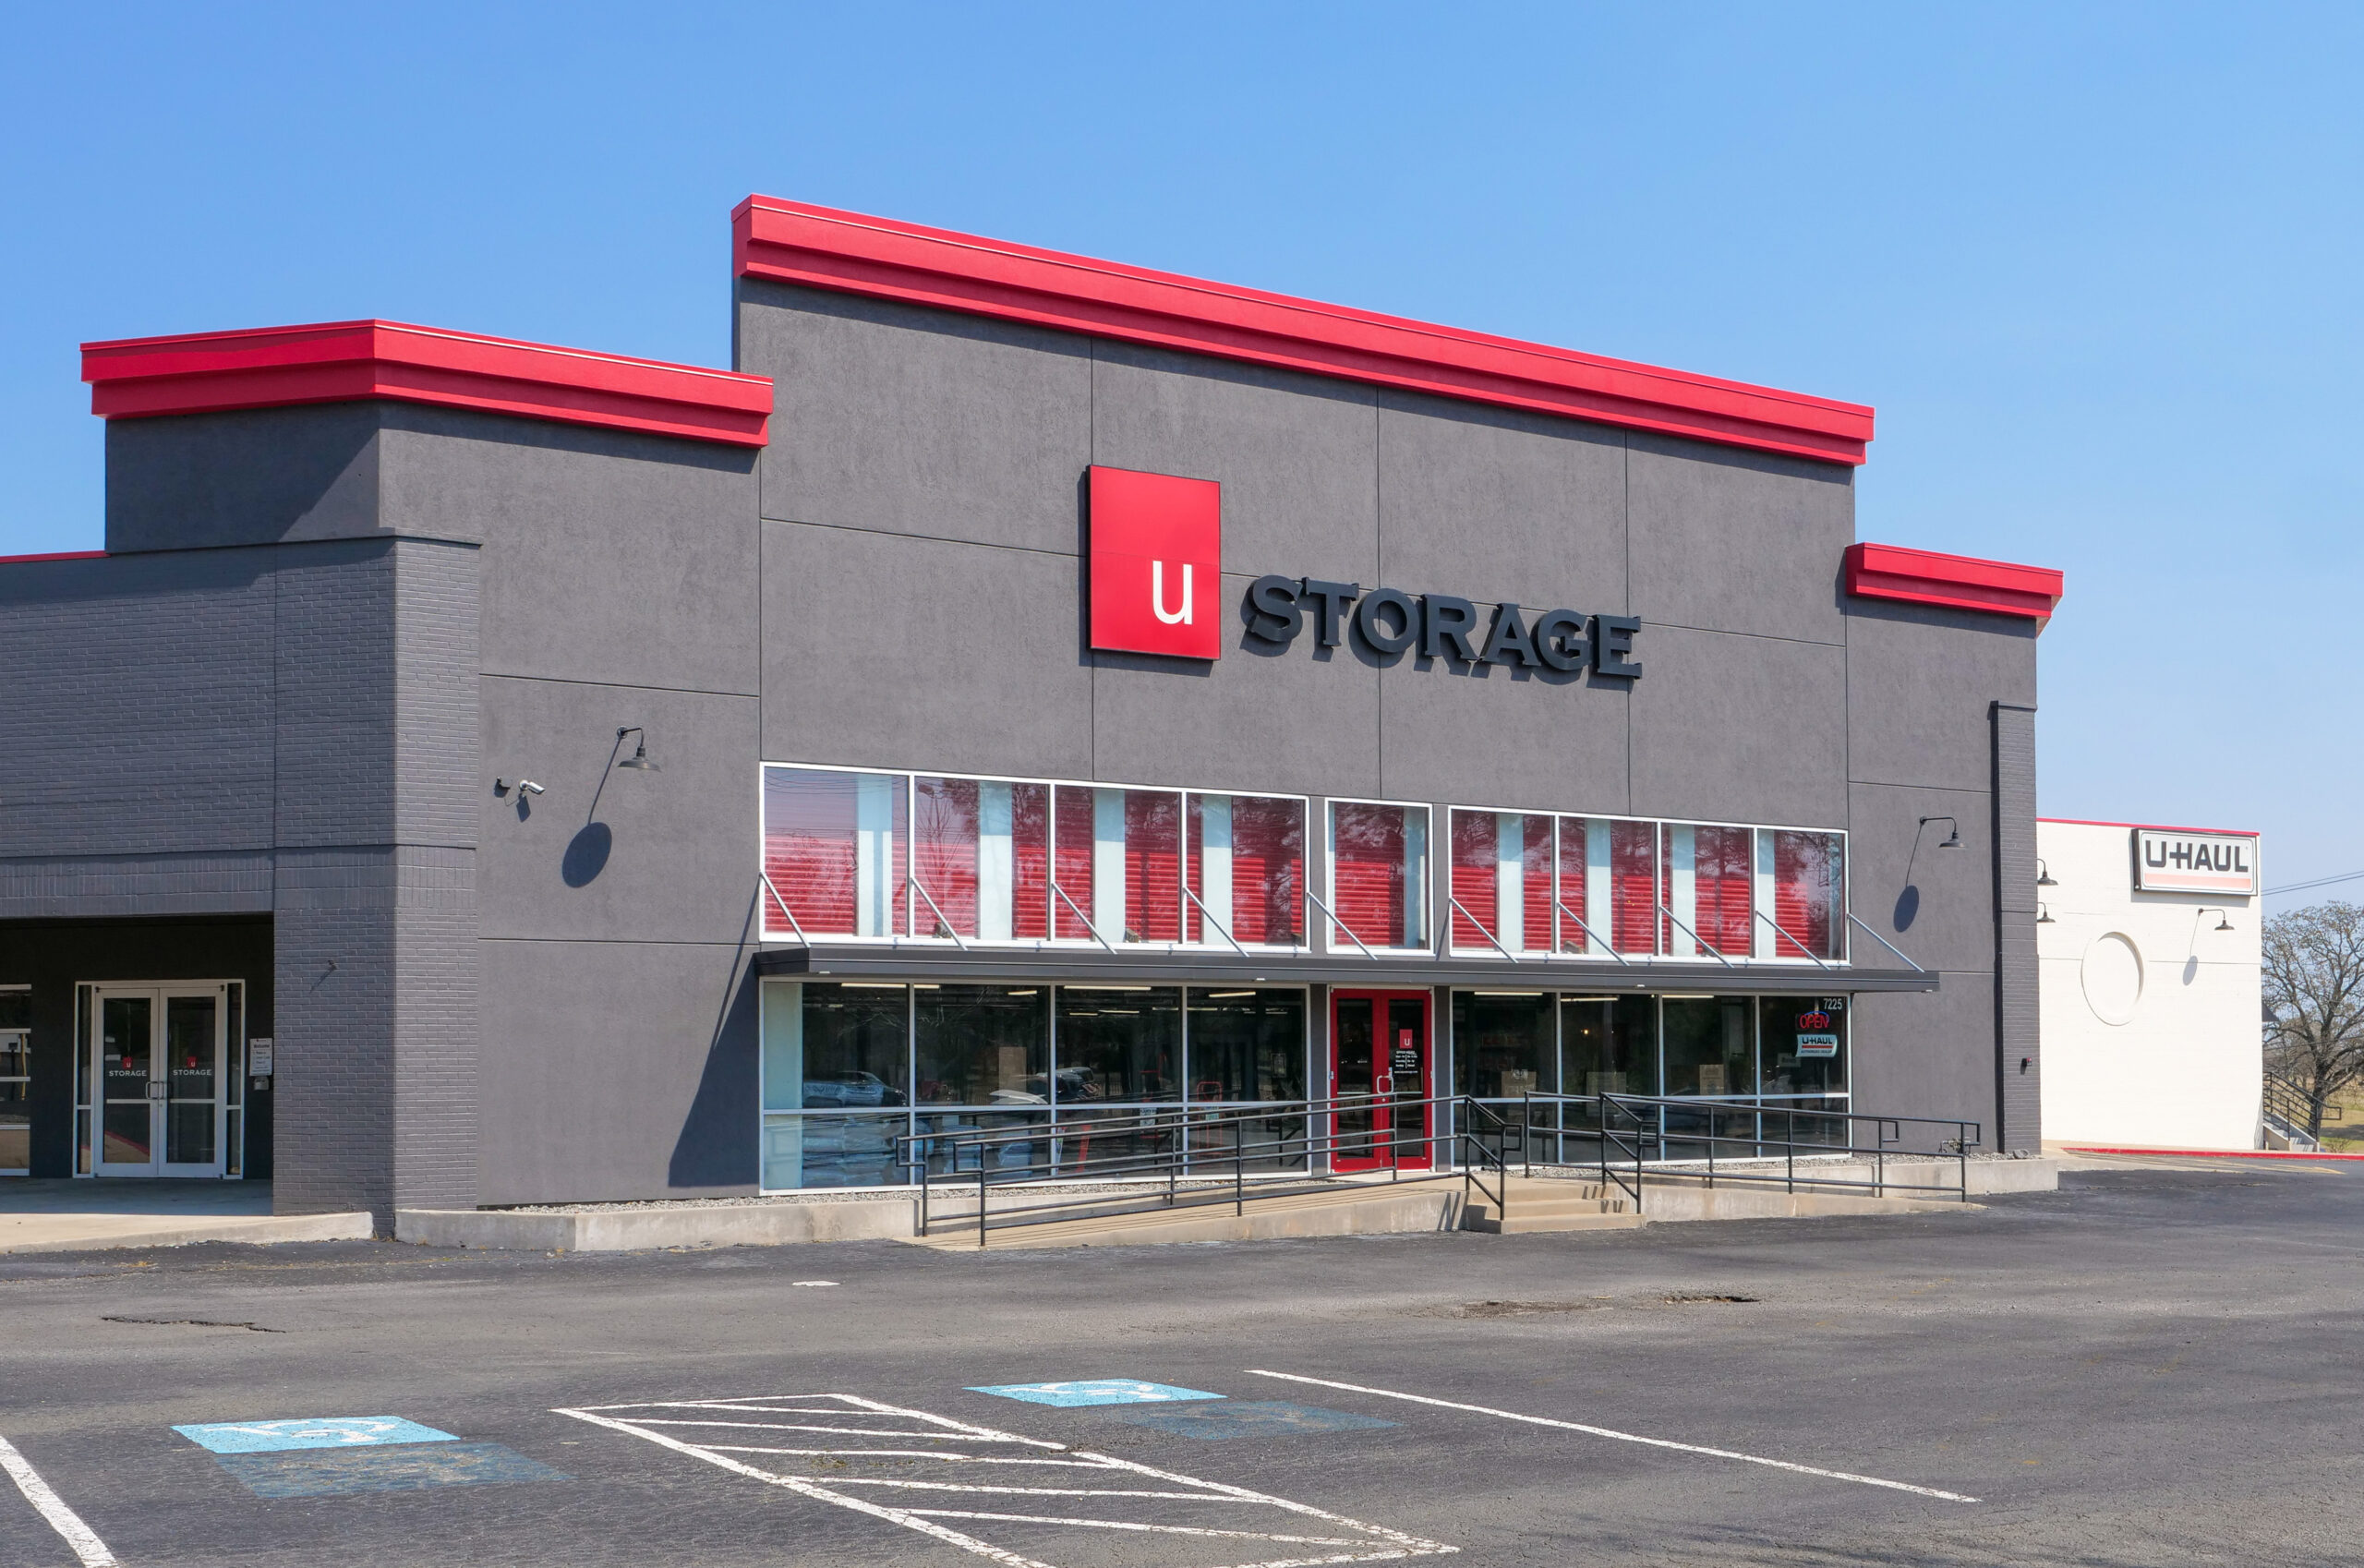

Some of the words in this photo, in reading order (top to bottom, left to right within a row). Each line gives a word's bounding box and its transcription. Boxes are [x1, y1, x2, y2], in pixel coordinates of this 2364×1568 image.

[1250, 574, 1644, 681] STORAGE
[2145, 839, 2249, 873] U-HAUL
[1823, 998, 1843, 1010] 7225
[1799, 1014, 1829, 1029] OPEN
[1802, 1036, 1833, 1044] U-HAUL
